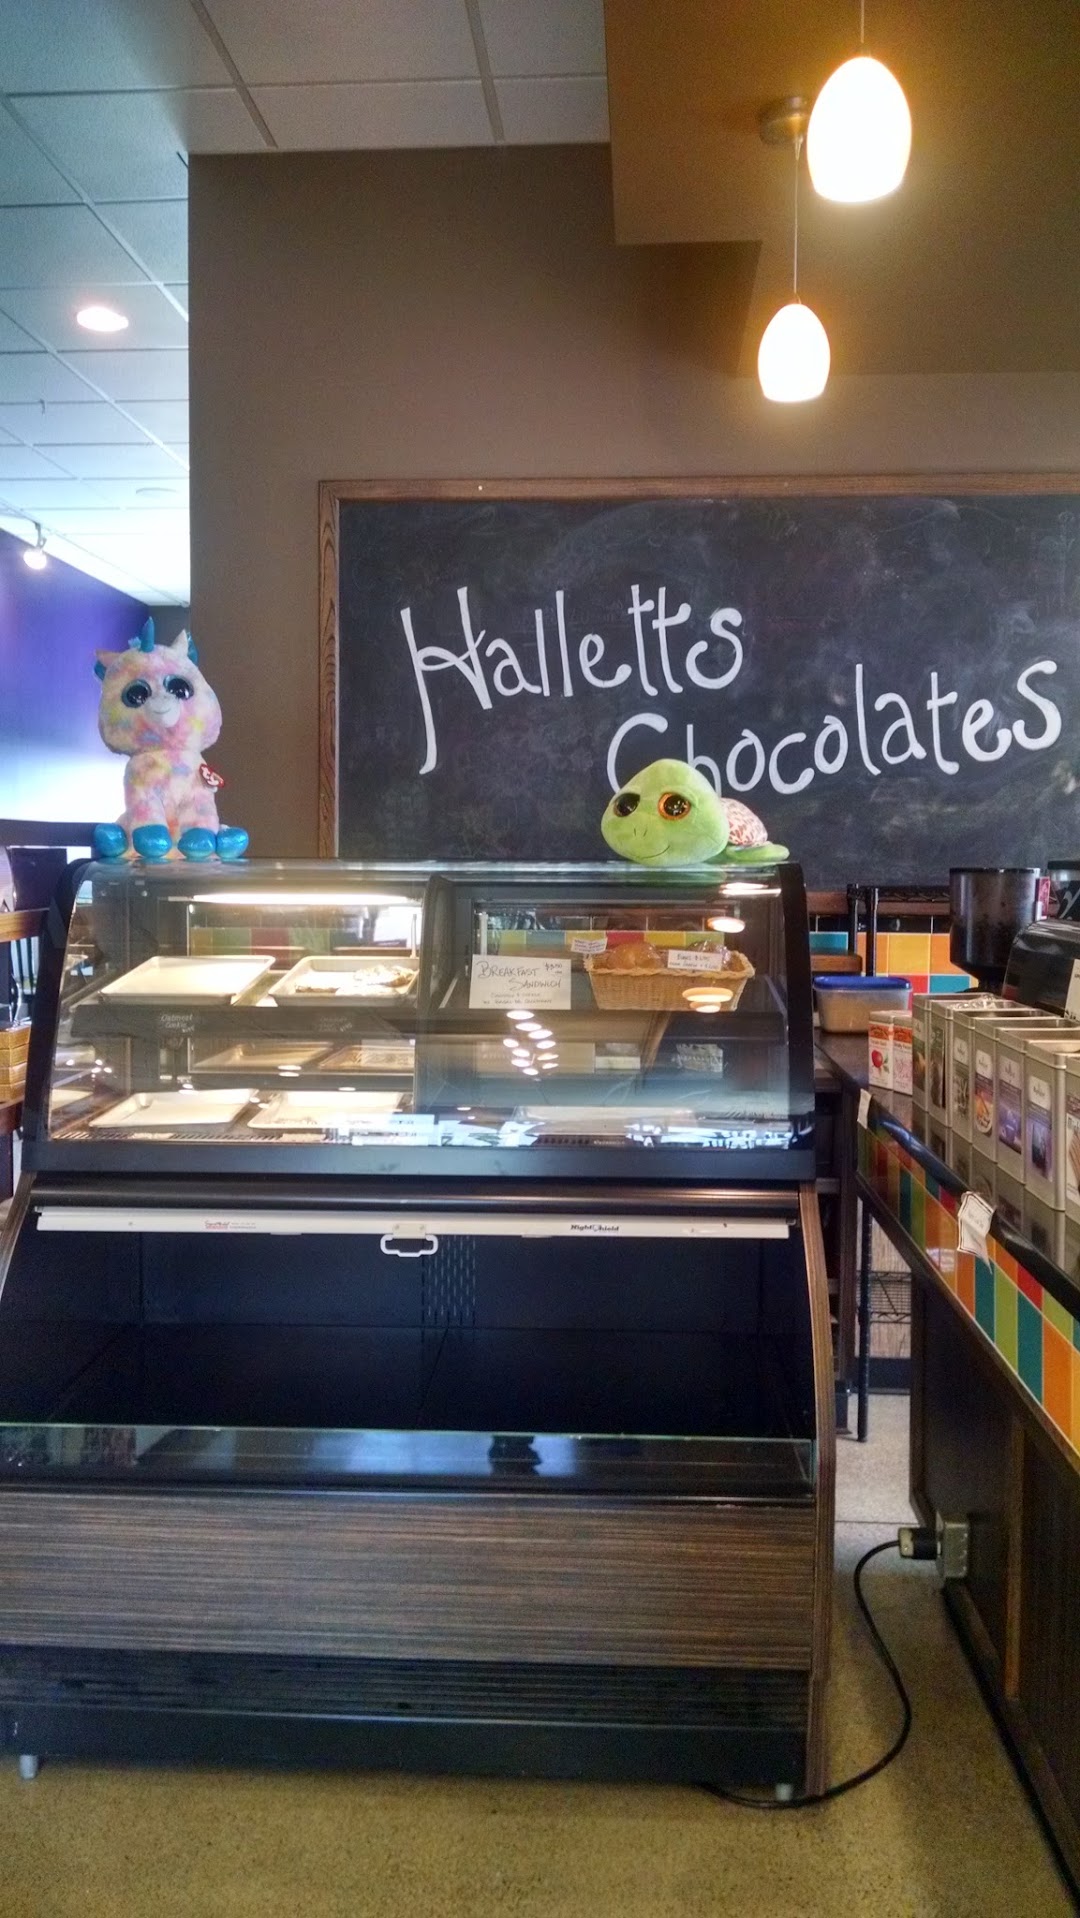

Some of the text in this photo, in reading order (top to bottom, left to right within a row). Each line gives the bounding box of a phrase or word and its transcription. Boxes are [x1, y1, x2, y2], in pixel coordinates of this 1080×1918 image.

[400, 583, 742, 776] Halletts
[476, 960, 541, 979] BREAKFAST
[508, 977, 562, 992] SANDWICH
